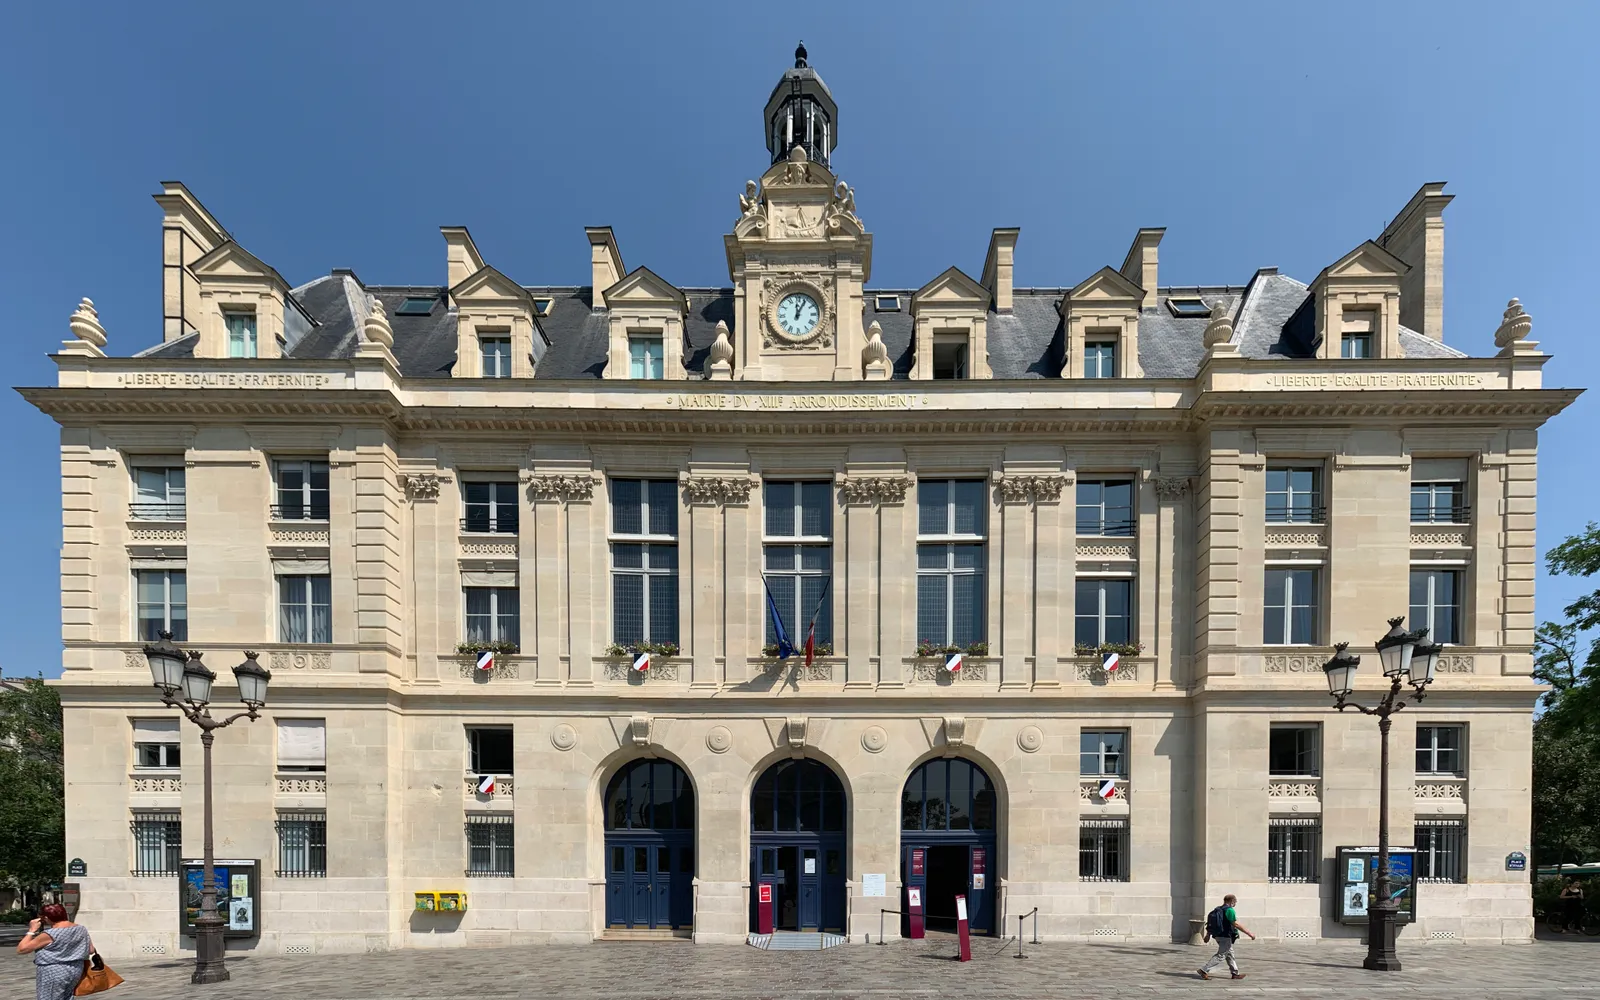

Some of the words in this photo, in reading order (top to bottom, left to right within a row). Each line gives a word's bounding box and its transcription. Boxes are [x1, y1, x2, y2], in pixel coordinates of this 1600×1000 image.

[125, 374, 177, 385] LIBERTE
[185, 374, 236, 385] EGALITE
[244, 375, 322, 386] FRATERNITE
[1274, 376, 1328, 387] LIBERTE
[1396, 375, 1476, 387] FRATERNITE
[678, 395, 726, 408] MAIRIE
[789, 395, 917, 408] ARRONDISSEMENT
